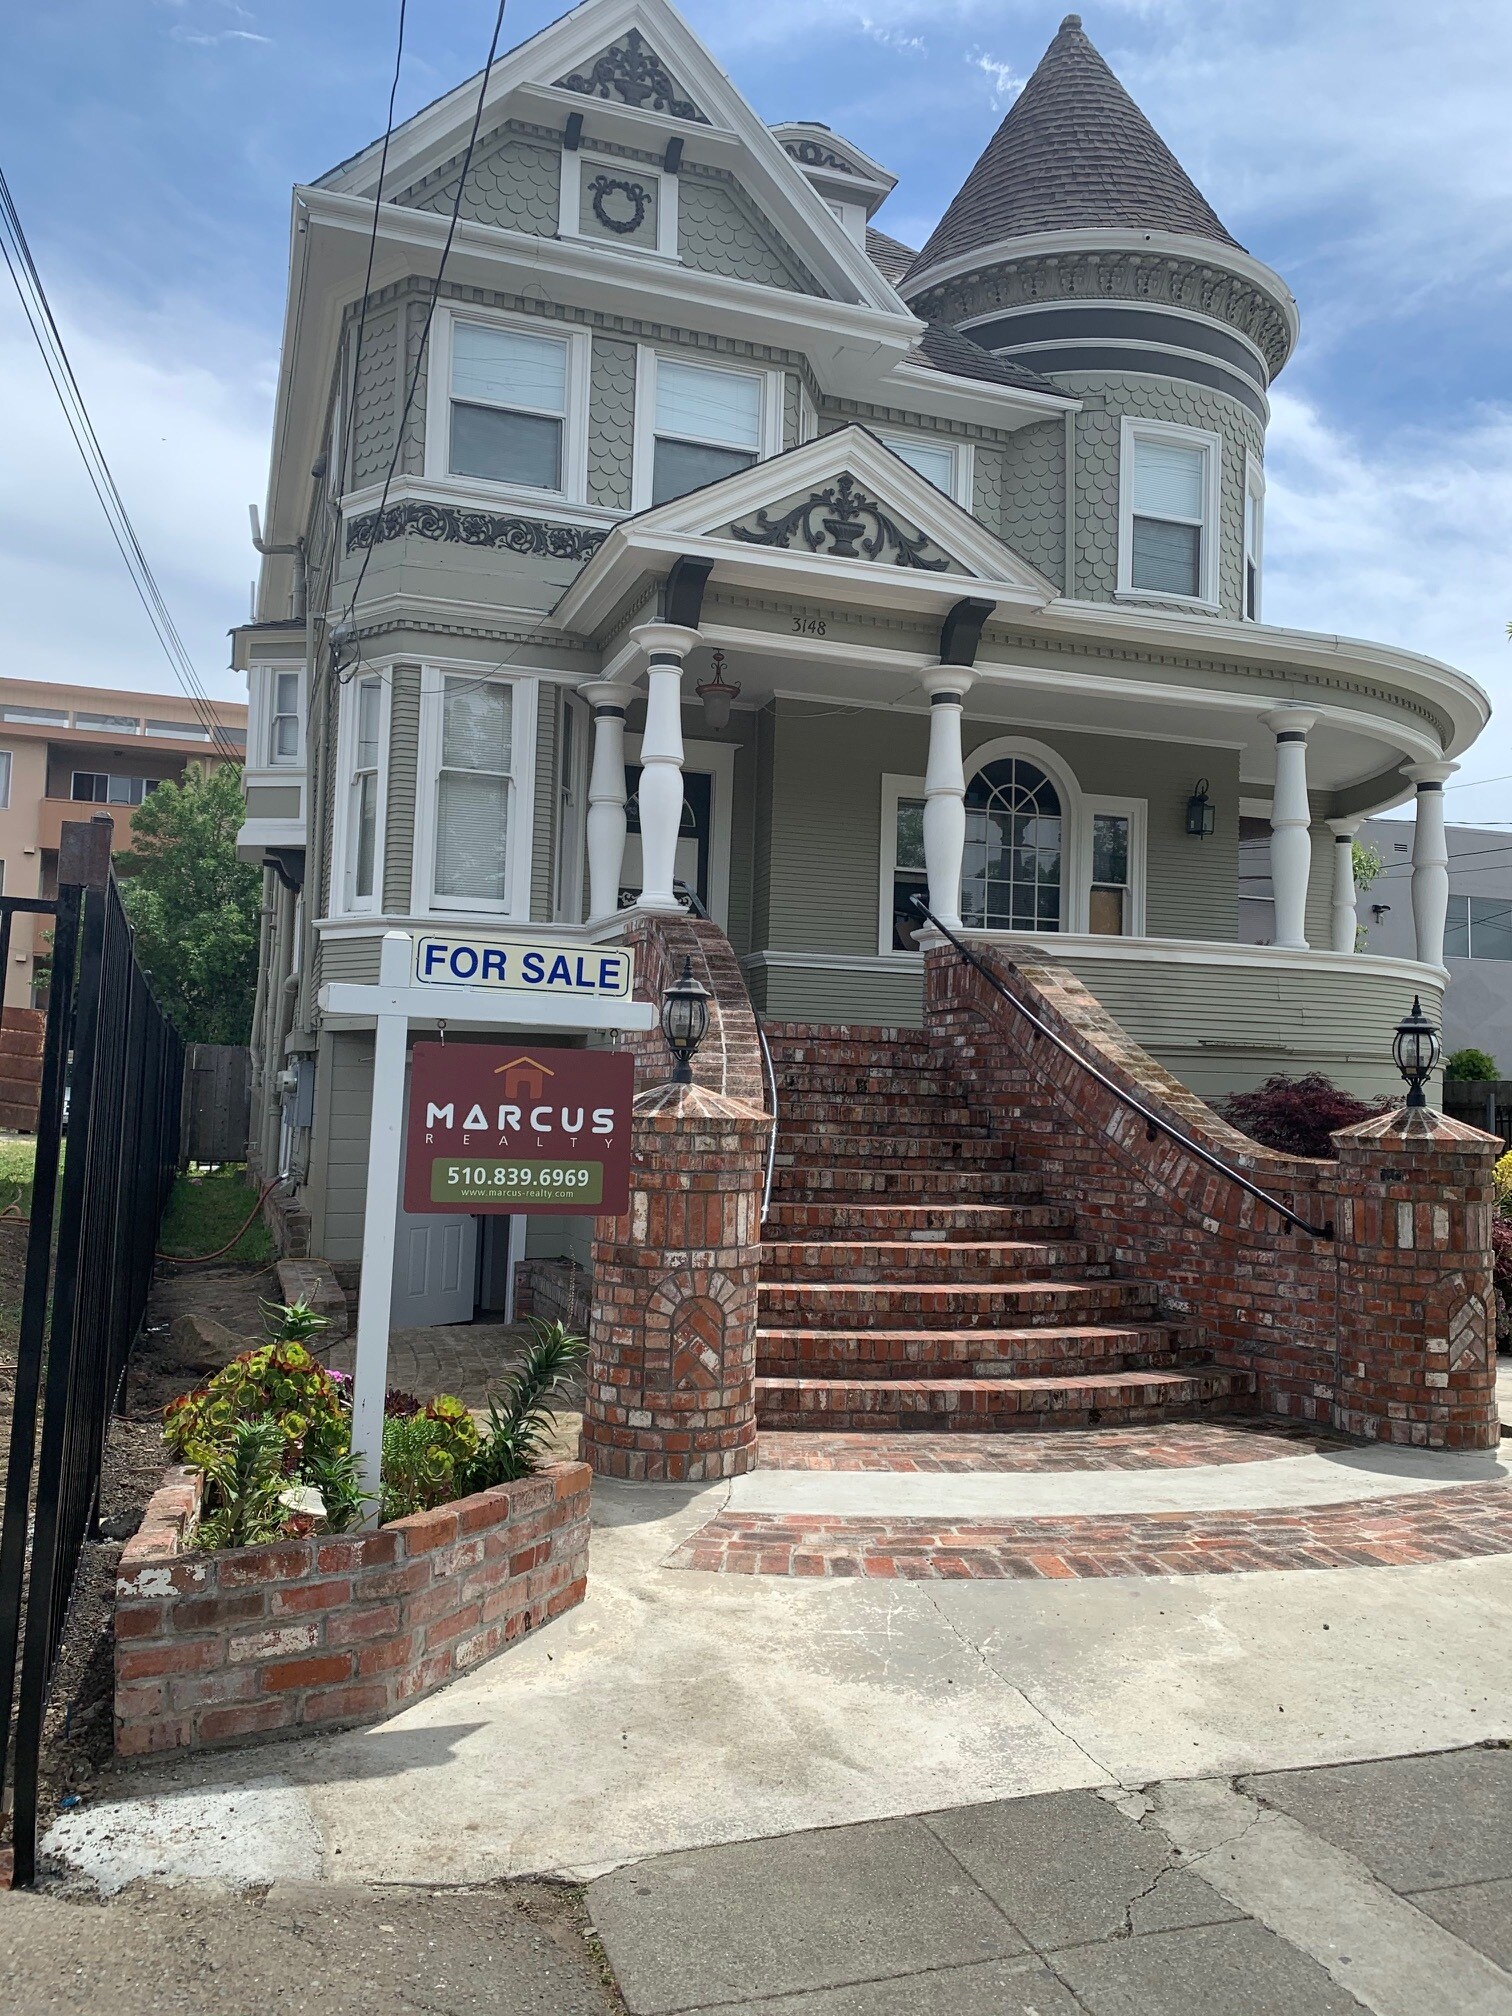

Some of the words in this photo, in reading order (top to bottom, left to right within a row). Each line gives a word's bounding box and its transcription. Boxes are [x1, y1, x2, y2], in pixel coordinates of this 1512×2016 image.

[792, 617, 826, 636] 3148
[425, 944, 507, 981] FOR
[521, 952, 621, 990] SALE
[426, 1102, 614, 1134] MARCUS
[425, 1133, 613, 1149] REALTY
[447, 1166, 589, 1187] 510.839.6969
[461, 1188, 574, 1199] www.marcus-realty.com
